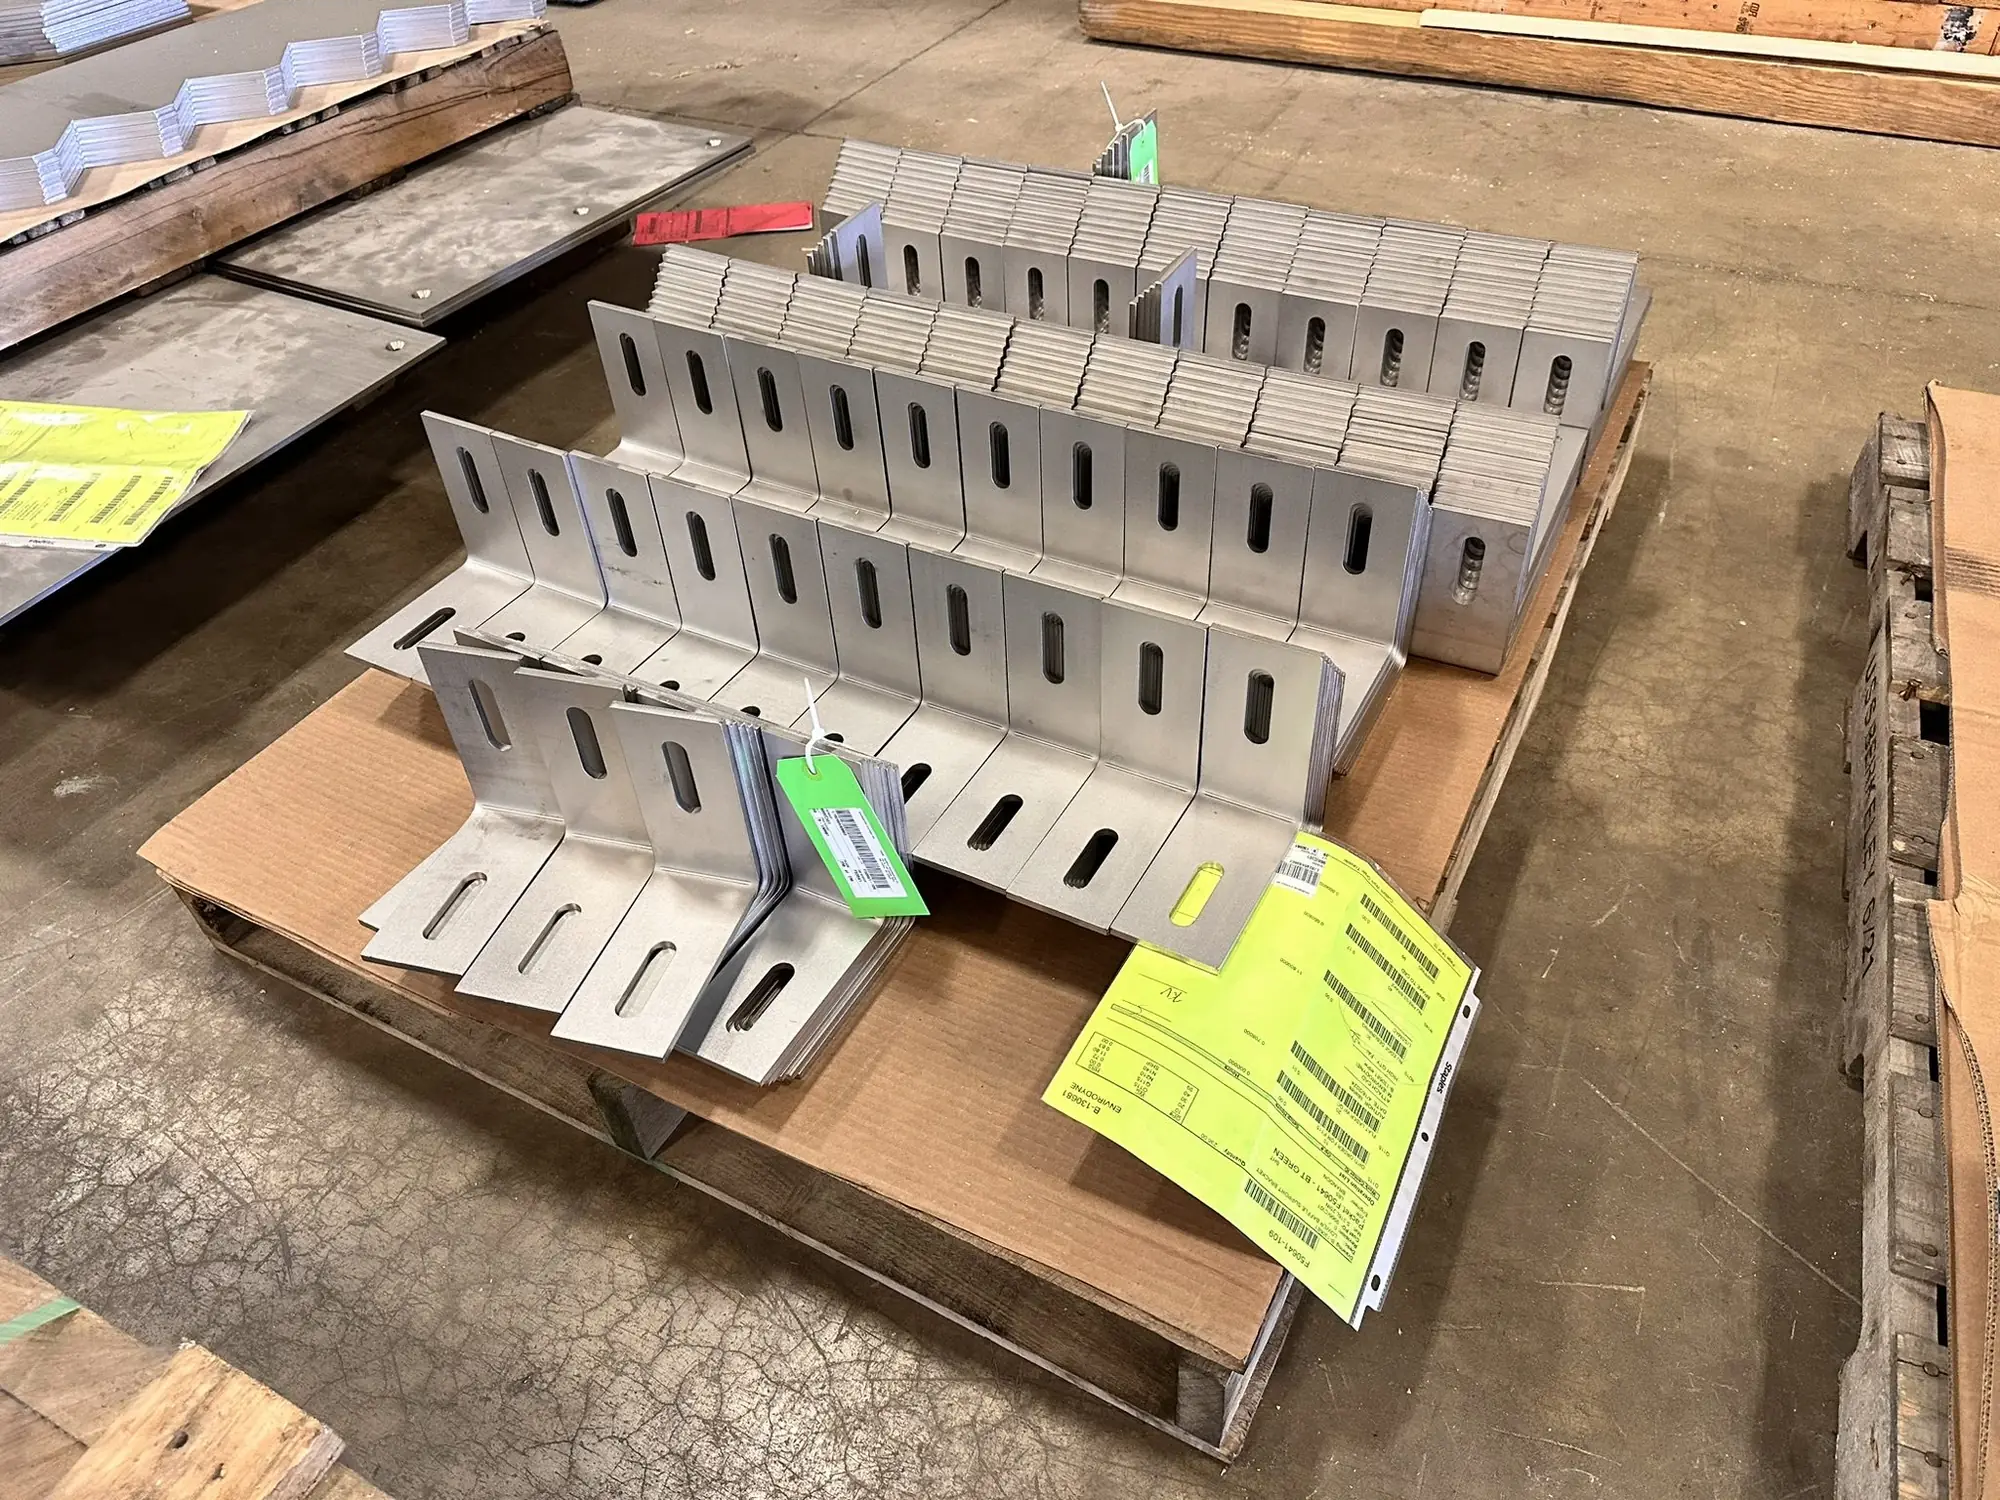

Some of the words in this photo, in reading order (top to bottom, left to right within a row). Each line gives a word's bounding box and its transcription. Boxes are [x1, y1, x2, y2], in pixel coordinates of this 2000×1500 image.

[1445, 955, 1455, 967] Page
[1400, 966, 1410, 980] CAD
[1409, 976, 1417, 986] TO
[1222, 1064, 1240, 1078] Hours
[1375, 1057, 1386, 1071] QTY
[1359, 1073, 1372, 1087] CAD
[1385, 1066, 1399, 1082] HIGH
[1436, 1061, 1453, 1094] Staples
[1061, 1088, 1101, 1114] B-130681
[1069, 1080, 1122, 1114] ENVIRODYNE
[1182, 1089, 1191, 1098] 40
[1370, 1083, 1391, 1105] ATTACH
[1173, 1106, 1182, 1114] 10
[1222, 1147, 1247, 1167] Quantity
[1271, 1145, 1300, 1175] GREEN
[1255, 1165, 1278, 1188] BRACKET
[1299, 1169, 1311, 1184] BT
[1337, 1170, 1350, 1185] List
[1277, 1184, 1302, 1209] SUPPORT
[1315, 1182, 1341, 1210] F50641
[1349, 1180, 1375, 1207] Operation
[1267, 1227, 1311, 1268] F50641-109
